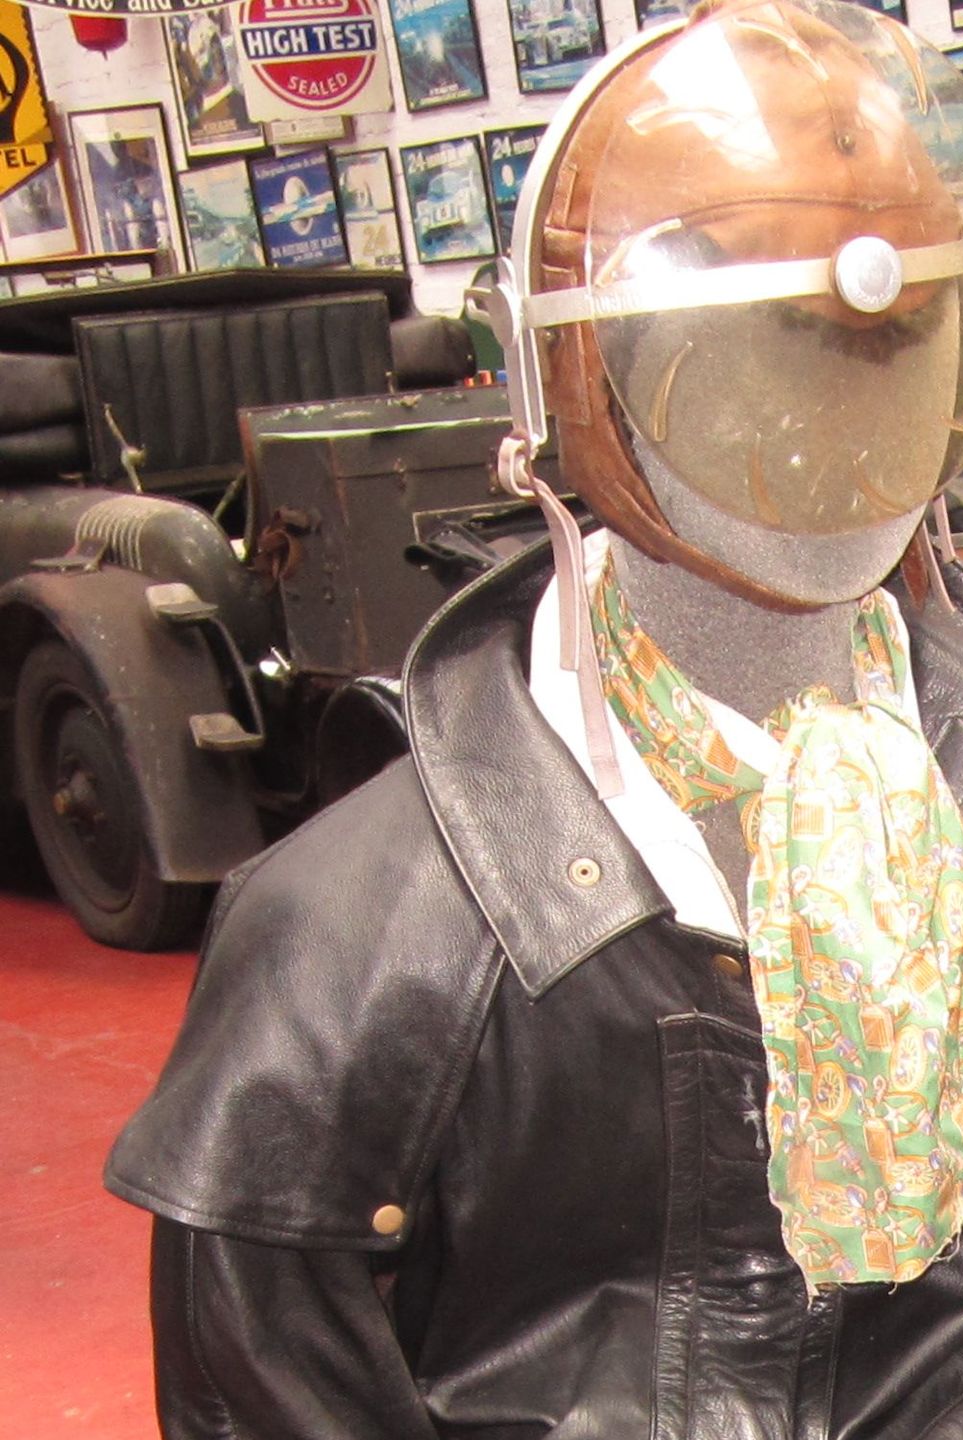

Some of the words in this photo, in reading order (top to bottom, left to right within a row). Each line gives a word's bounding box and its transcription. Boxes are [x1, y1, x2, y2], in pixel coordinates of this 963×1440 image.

[246, 29, 309, 57] HIGH
[312, 23, 373, 50] TEST
[288, 72, 348, 96] SEALED
[0, 147, 37, 169] EL
